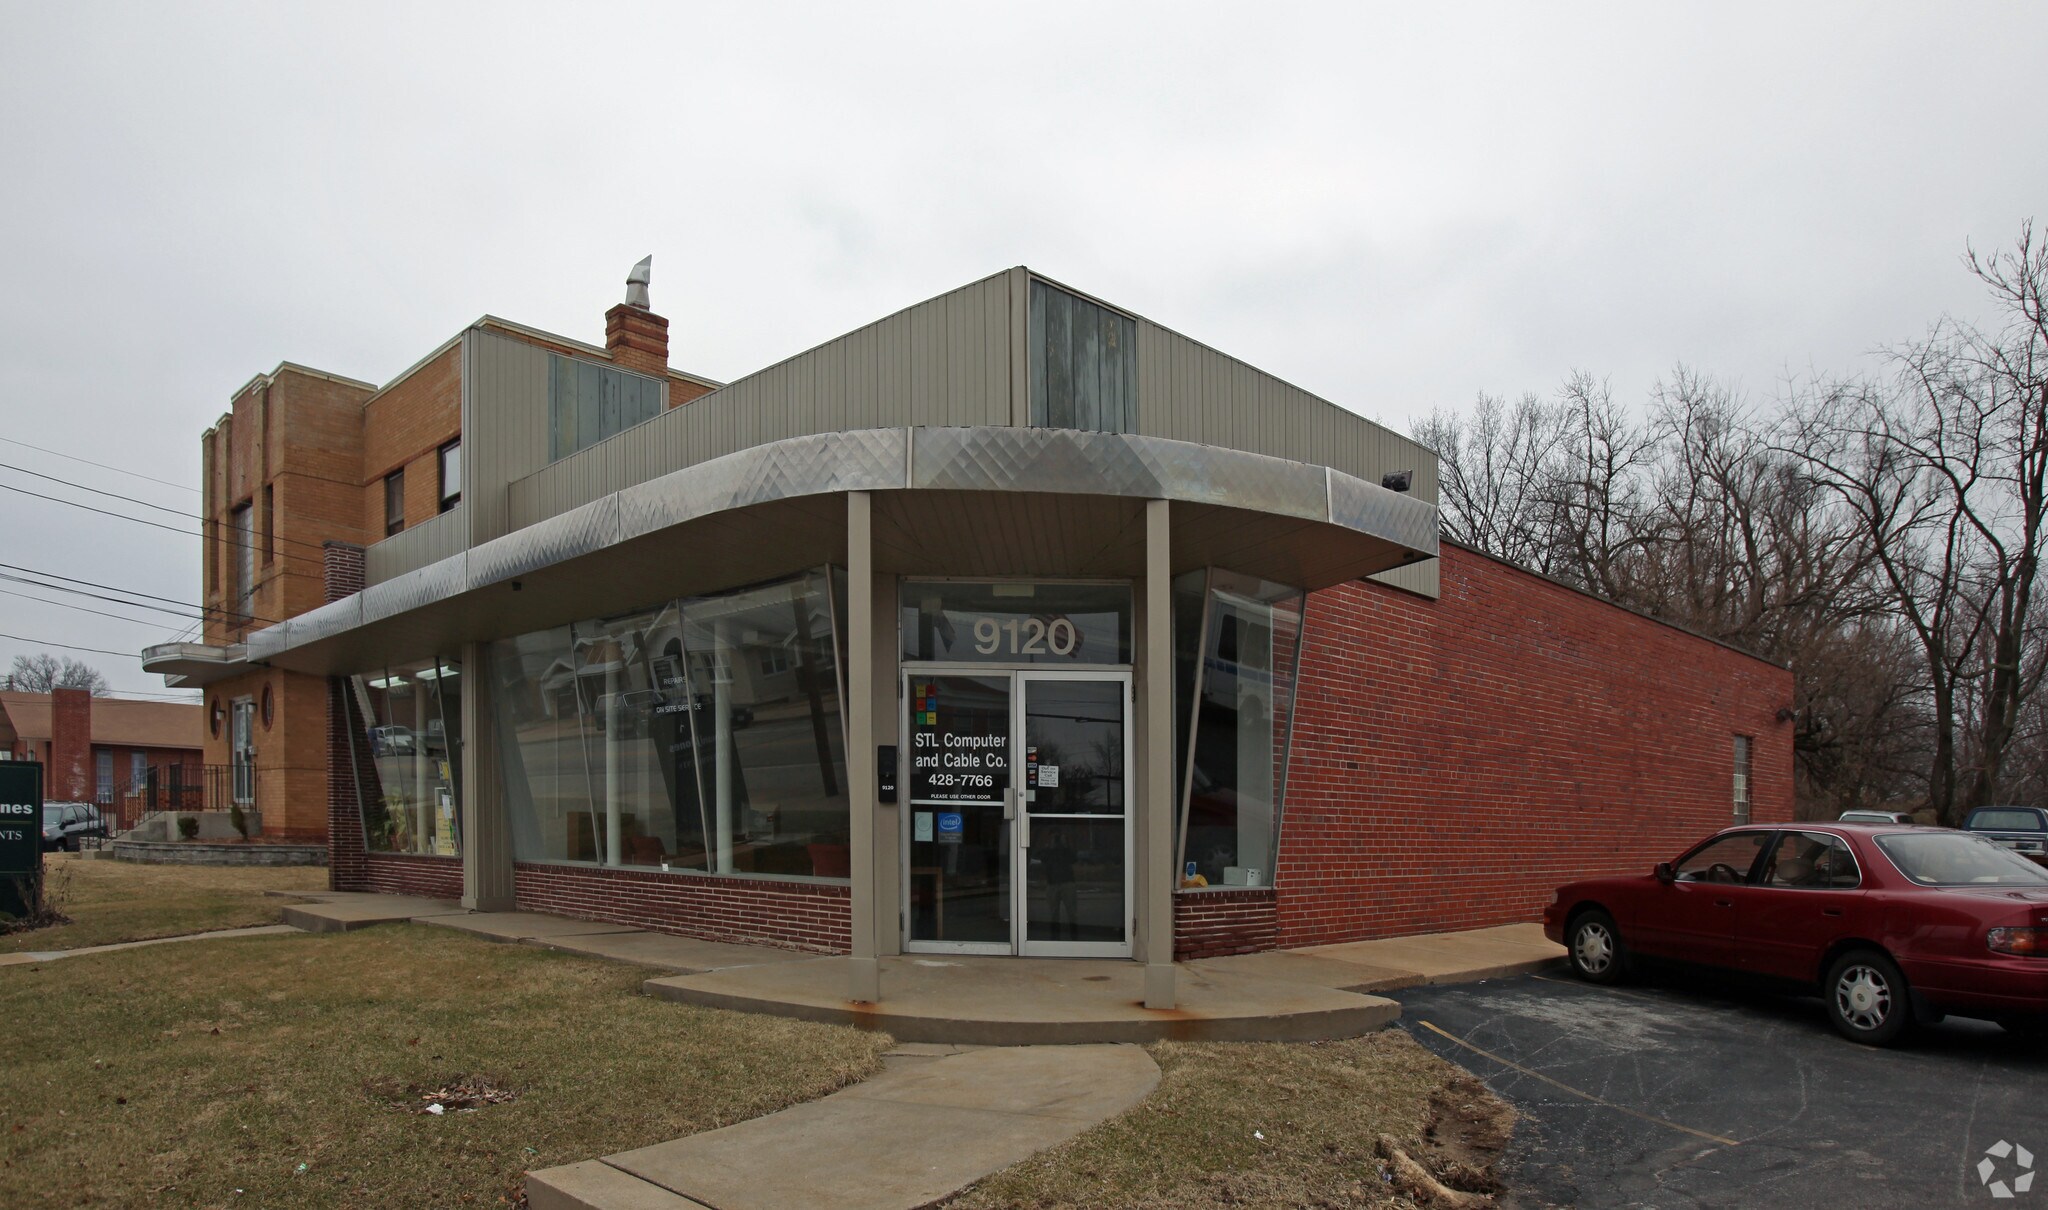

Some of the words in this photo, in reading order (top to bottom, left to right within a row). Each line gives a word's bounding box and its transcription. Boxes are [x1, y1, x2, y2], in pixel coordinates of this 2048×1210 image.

[974, 618, 1076, 655] 9120
[663, 676, 687, 685] REPAIRS
[656, 706, 665, 714] ON
[665, 705, 677, 713] SITE
[678, 703, 702, 711] SERCE
[915, 733, 939, 747] STL
[944, 733, 1006, 750] Computer
[915, 753, 939, 768] and
[944, 753, 980, 768] Cable
[985, 753, 1007, 768] Co.
[928, 774, 993, 787] 428-7766
